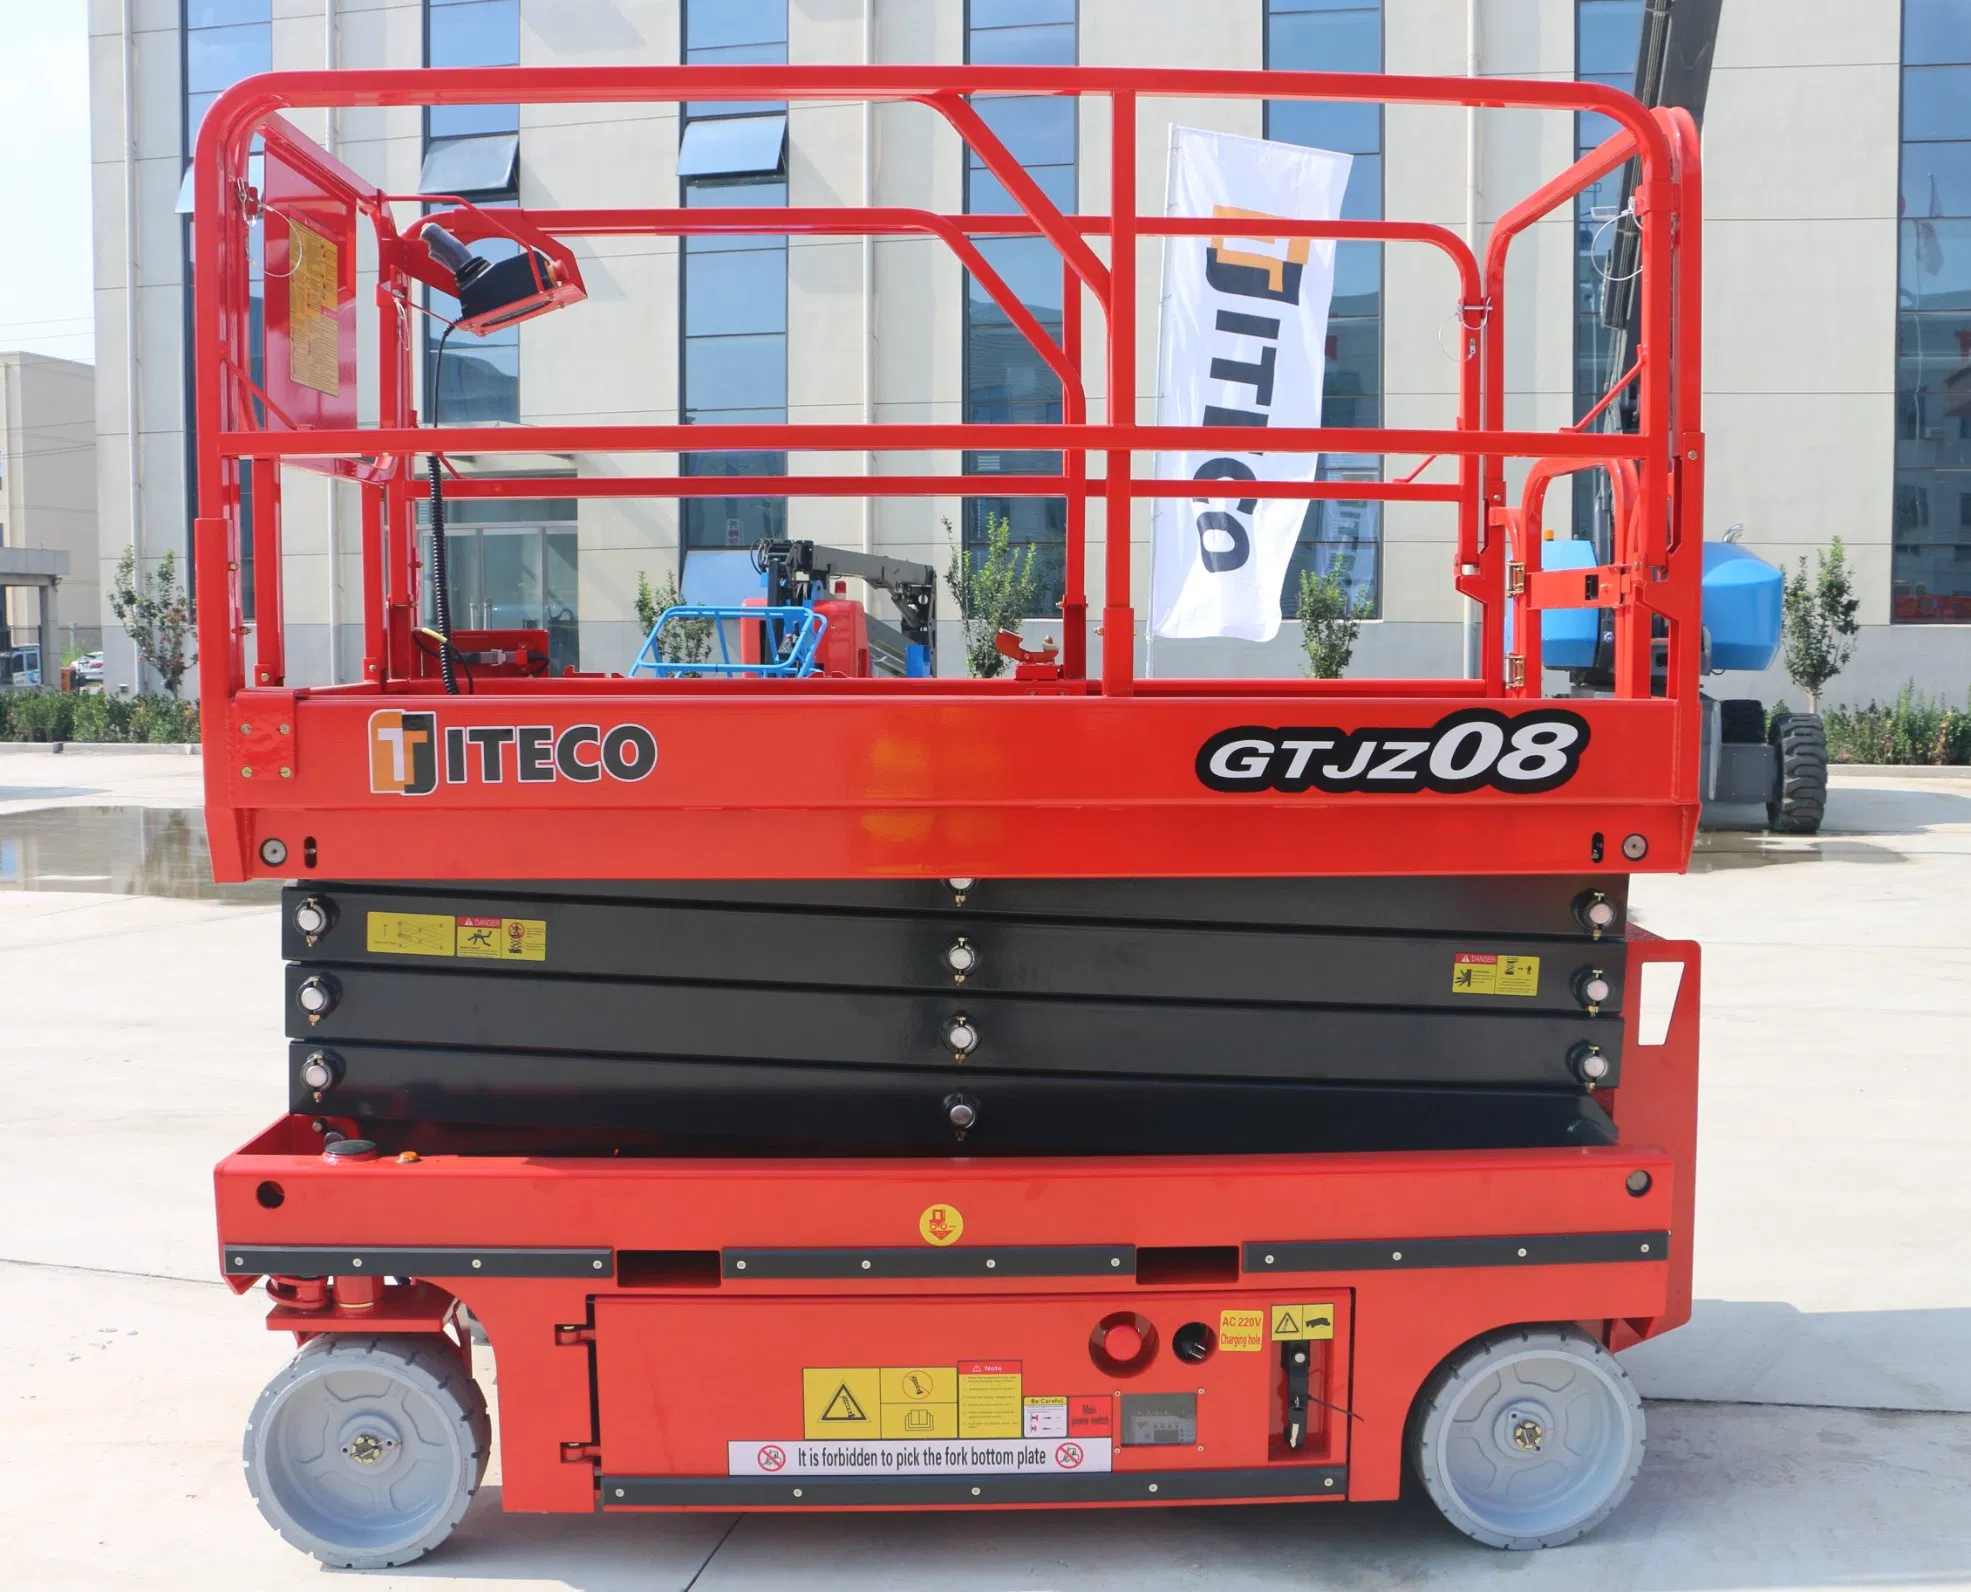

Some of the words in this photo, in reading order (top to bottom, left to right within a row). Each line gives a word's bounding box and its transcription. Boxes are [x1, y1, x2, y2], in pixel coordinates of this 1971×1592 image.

[1209, 721, 1579, 780] GTJZ08
[1471, 955, 1496, 963] DANGER
[1222, 1316, 1236, 1327] AC
[1238, 1317, 1262, 1327] 220V
[1220, 1333, 1247, 1347] Charging
[1248, 1334, 1261, 1345] hole
[1082, 1404, 1096, 1414] Main
[798, 1447, 806, 1467] It
[810, 1448, 819, 1467] is
[822, 1447, 878, 1467] forbidden
[881, 1450, 891, 1467] to
[896, 1447, 920, 1471] pick
[923, 1446, 942, 1466] the
[945, 1446, 968, 1466] fork
[971, 1446, 1014, 1465] bottom
[1017, 1445, 1046, 1469] plate
